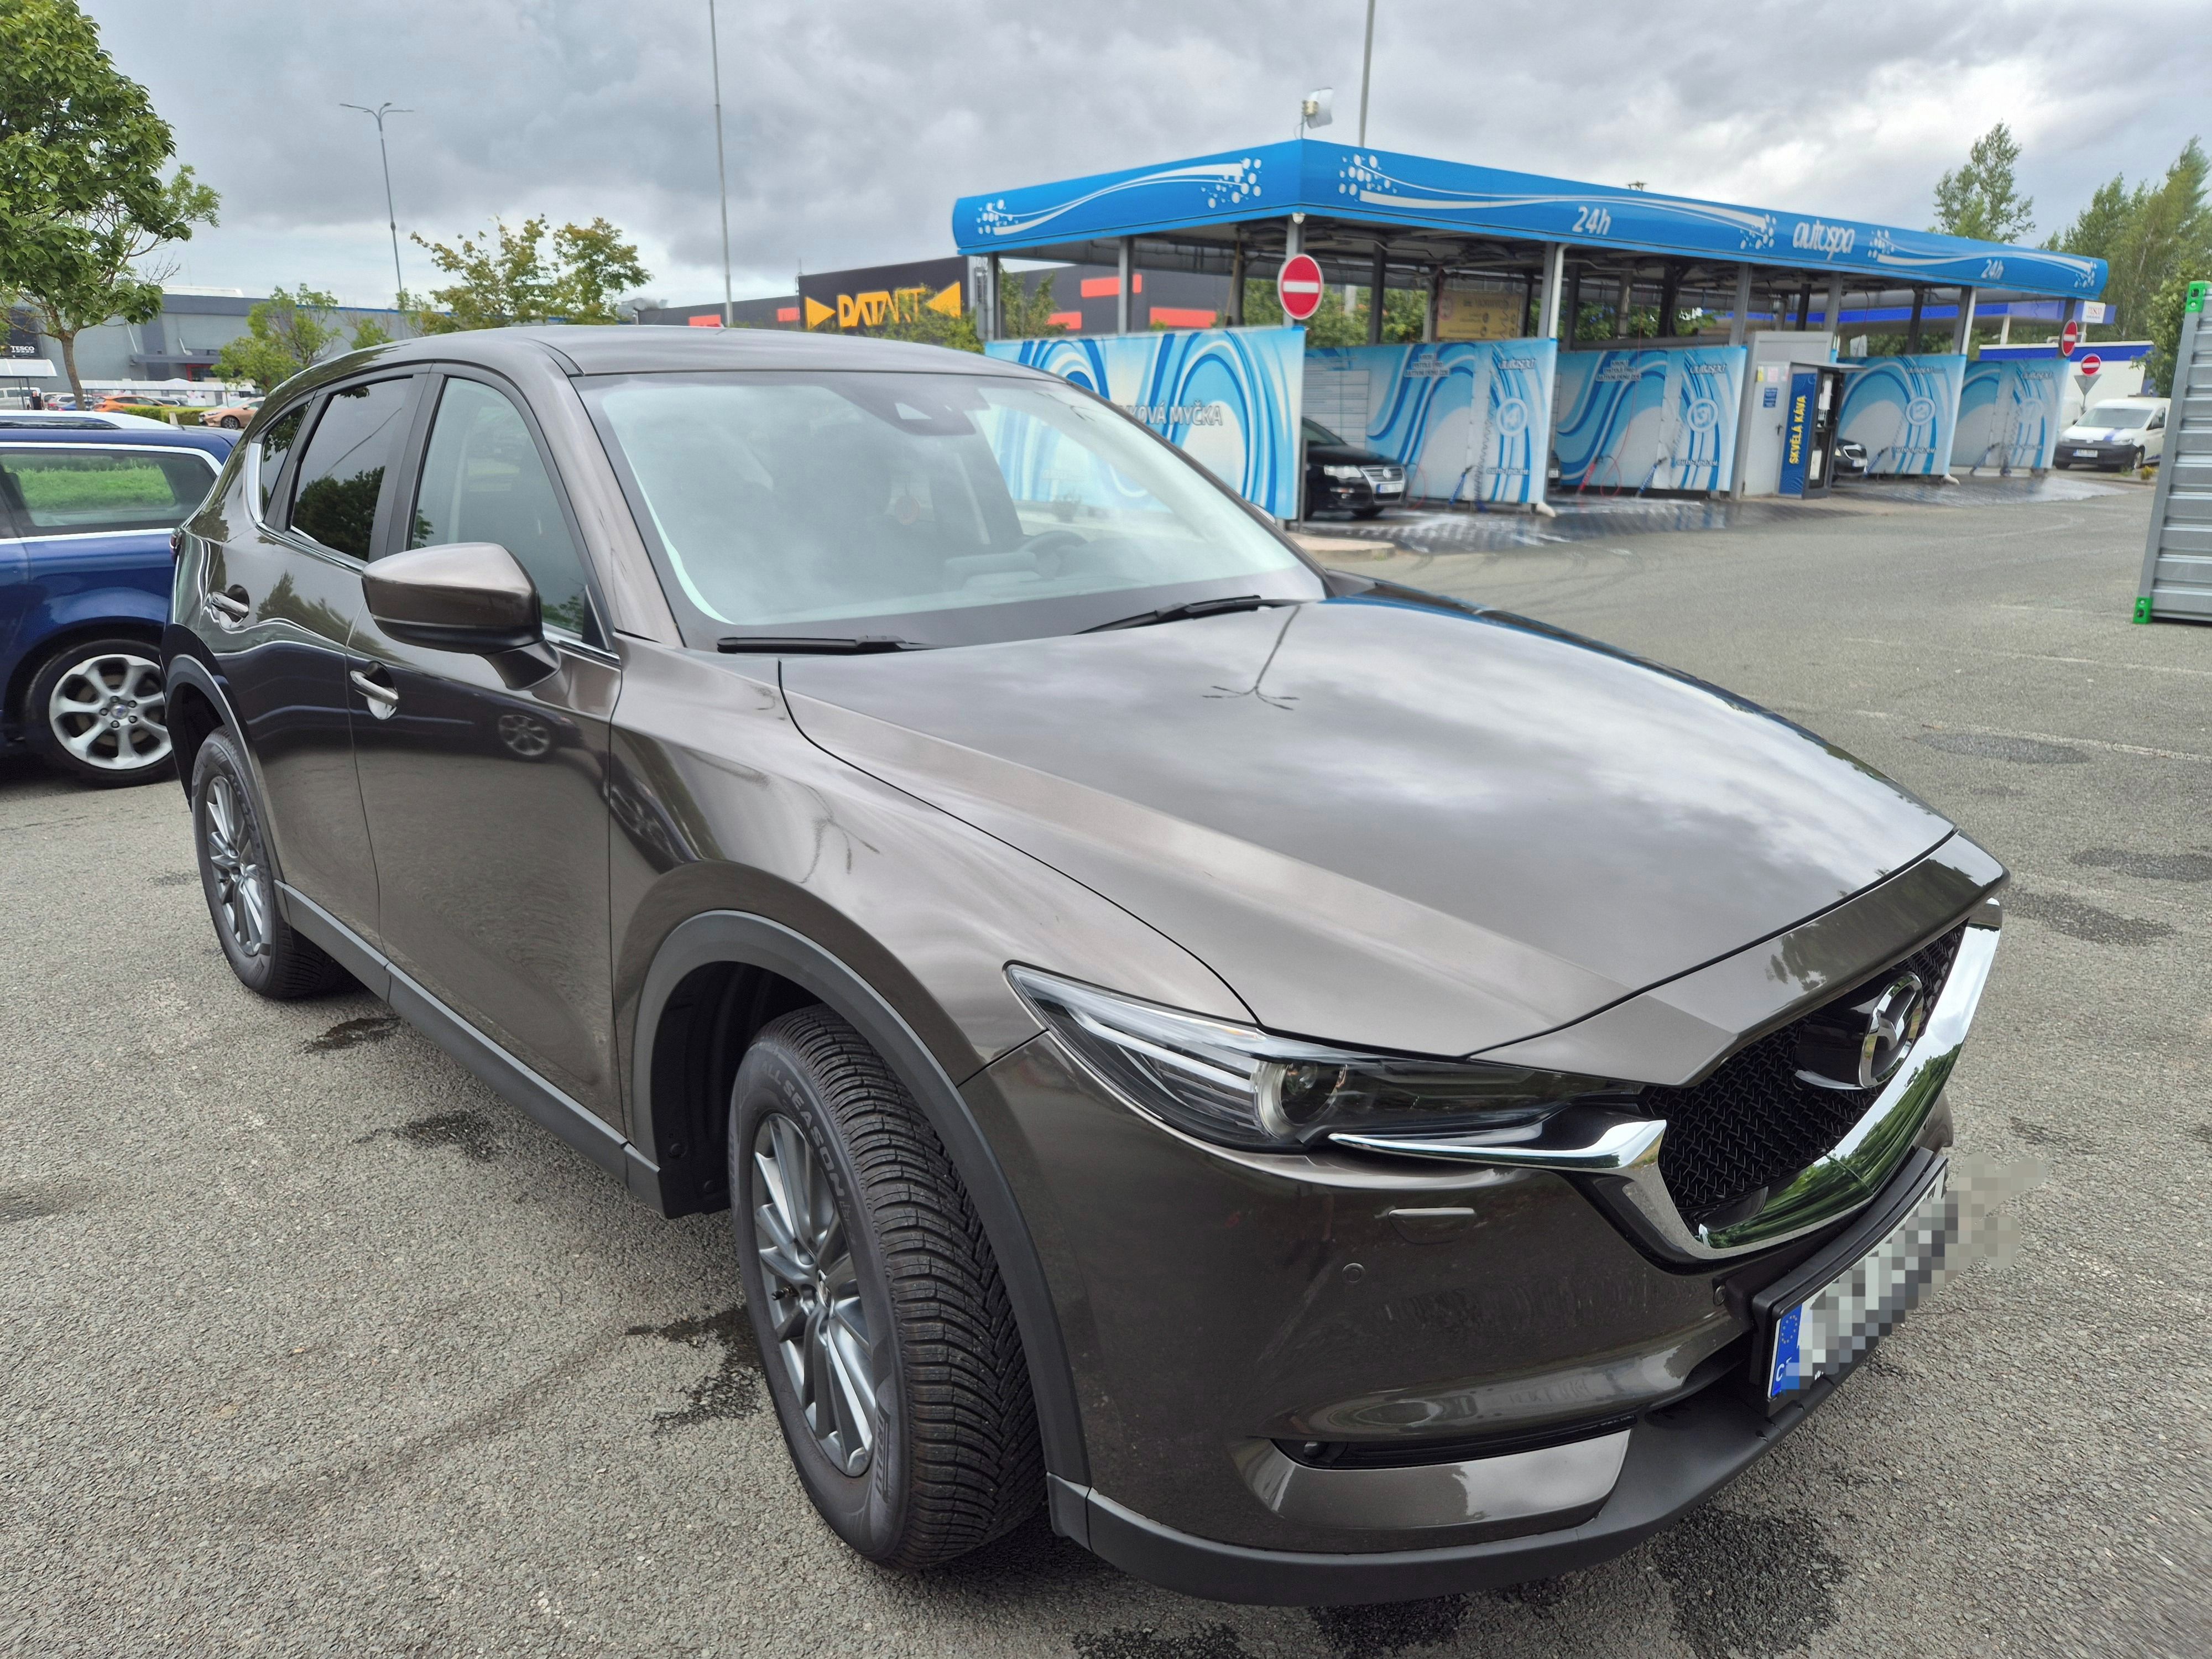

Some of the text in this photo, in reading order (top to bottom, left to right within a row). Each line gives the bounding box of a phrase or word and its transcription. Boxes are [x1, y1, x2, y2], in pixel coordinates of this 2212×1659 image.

[1572, 207, 1611, 235] 24h
[1792, 219, 1855, 262] autospa
[1981, 258, 2004, 280] 24h
[1170, 400, 1223, 425] MYČKA
[783, 1079, 845, 1197] SEASON
